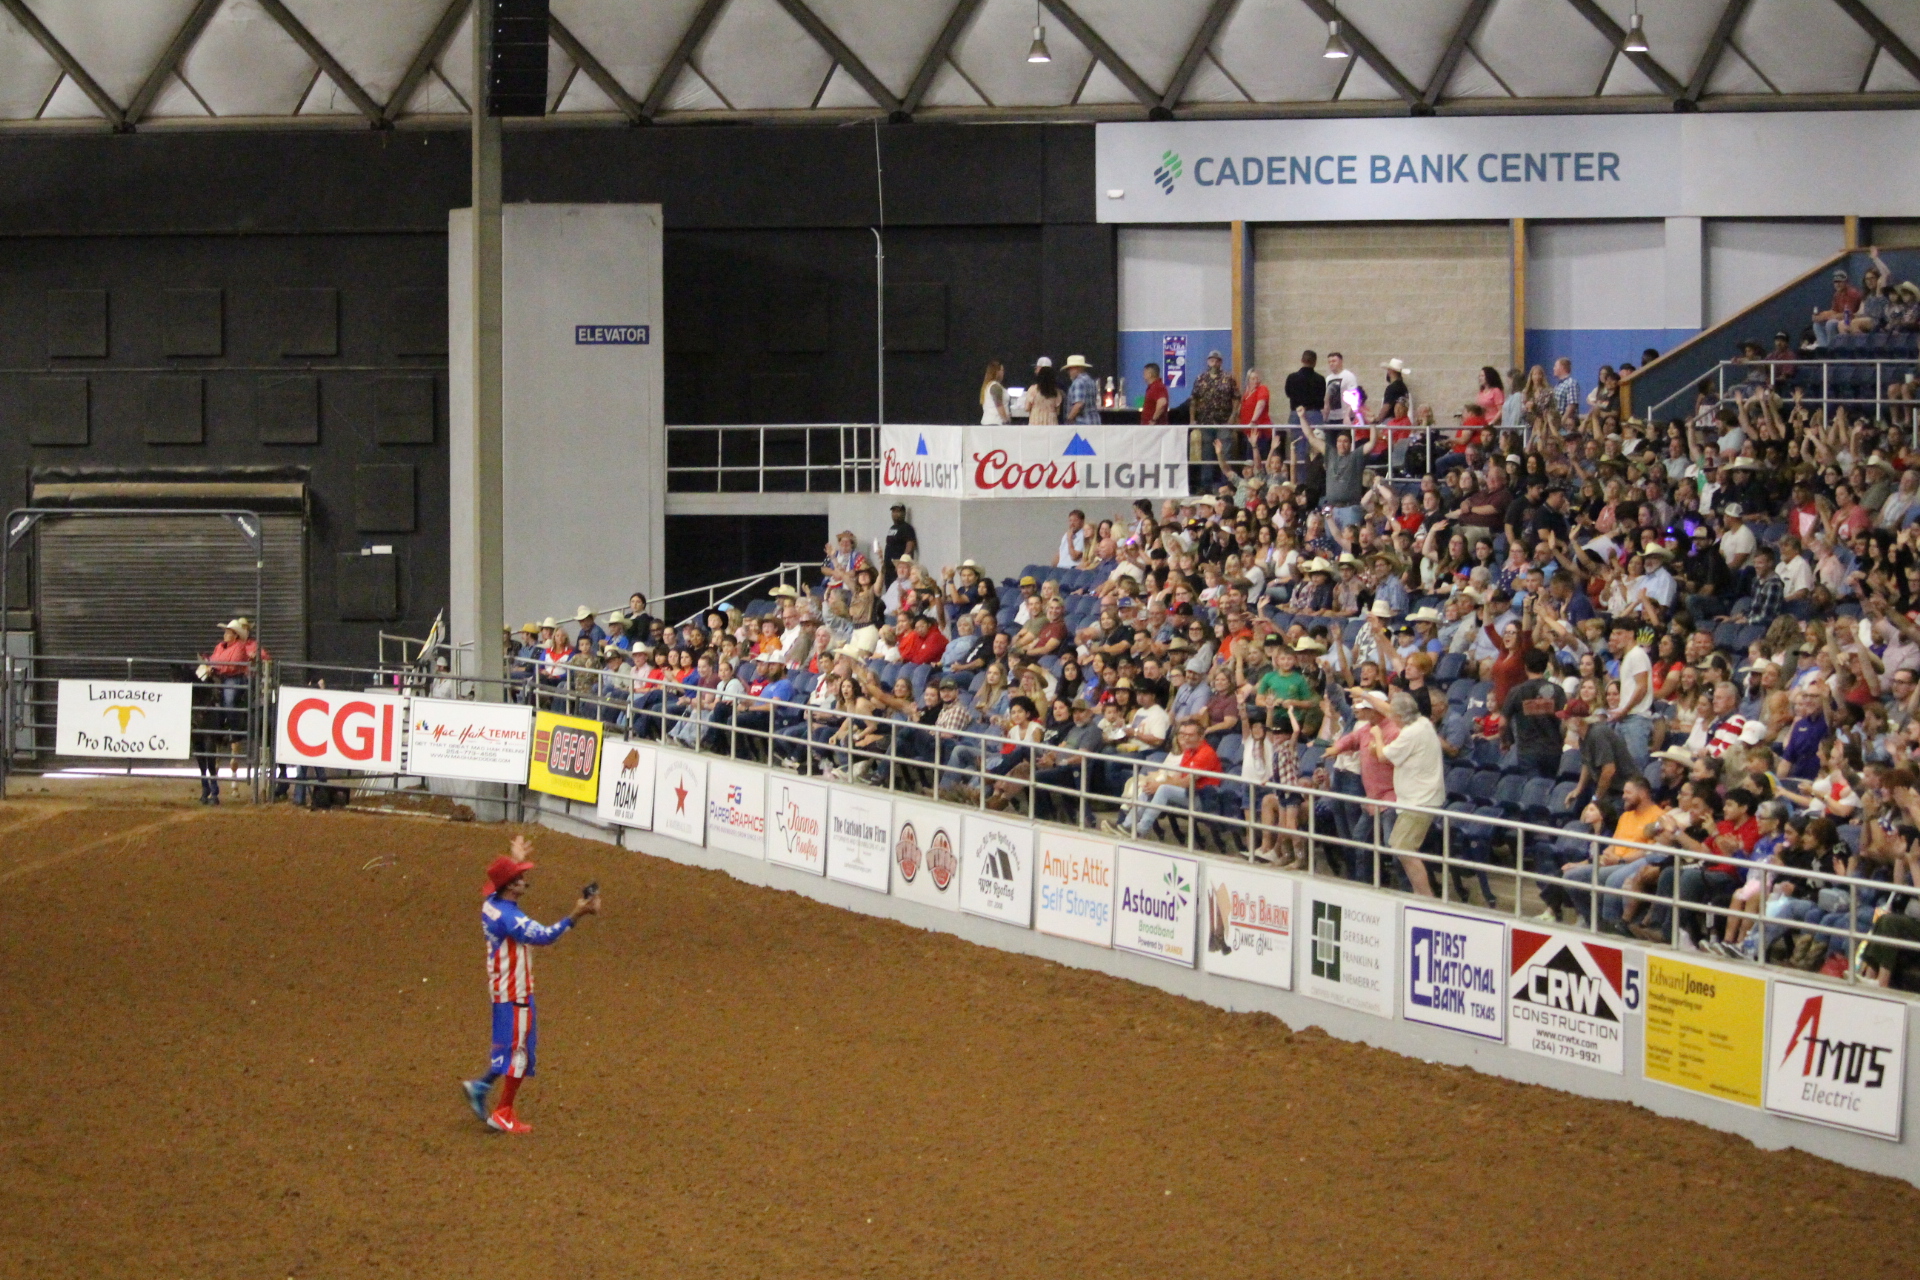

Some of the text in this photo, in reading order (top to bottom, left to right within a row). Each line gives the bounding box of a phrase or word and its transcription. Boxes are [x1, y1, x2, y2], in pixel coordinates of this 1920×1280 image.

[1193, 151, 1621, 187] CADENCE BANK CENTER
[578, 327, 646, 342] ELEVATOR
[1167, 370, 1183, 388] 7
[883, 447, 959, 490] Coors LIGHT
[972, 449, 1180, 490] Coors LIGHT
[88, 683, 163, 703] Lancaster
[77, 731, 169, 753] Pro Rodeo Co.
[287, 697, 394, 762] CGI
[432, 724, 457, 742] Mac
[458, 724, 489, 744] Haik
[488, 729, 527, 740] TEMPLE
[550, 730, 595, 776] CEFCO
[613, 780, 639, 811] ROAM
[787, 801, 819, 837] Tanner
[833, 816, 843, 833] The
[843, 819, 862, 838] Carlson
[862, 822, 874, 841] Law
[874, 826, 887, 844] Firm
[795, 836, 819, 863] Roofing
[1042, 849, 1079, 885] Amy's
[1082, 857, 1109, 887] Attic
[993, 882, 1015, 901] Roofing
[1041, 884, 1109, 926] Self Storage
[1258, 895, 1290, 930] BARN
[1343, 908, 1381, 927] BROCKWAY
[1138, 920, 1175, 940] Broadband
[1343, 930, 1380, 948] GERSBACH
[1433, 930, 1467, 960] FIRST
[1157, 943, 1164, 952] by
[1342, 951, 1380, 970] FRANKLIN &
[1433, 958, 1496, 995] NATIONAL
[1527, 963, 1602, 1017] CRW
[1624, 968, 1640, 1010] 5
[1684, 973, 1716, 999] Jones
[1433, 985, 1496, 1021] BANK TEXAS
[1512, 1005, 1618, 1041] CONSTRUCTION
[1532, 1038, 1601, 1064] (254) 773-9921
[1536, 1028, 1598, 1050] www.crwtx.com
[1778, 994, 1893, 1089] AMOS
[1801, 1082, 1861, 1112] Electric
